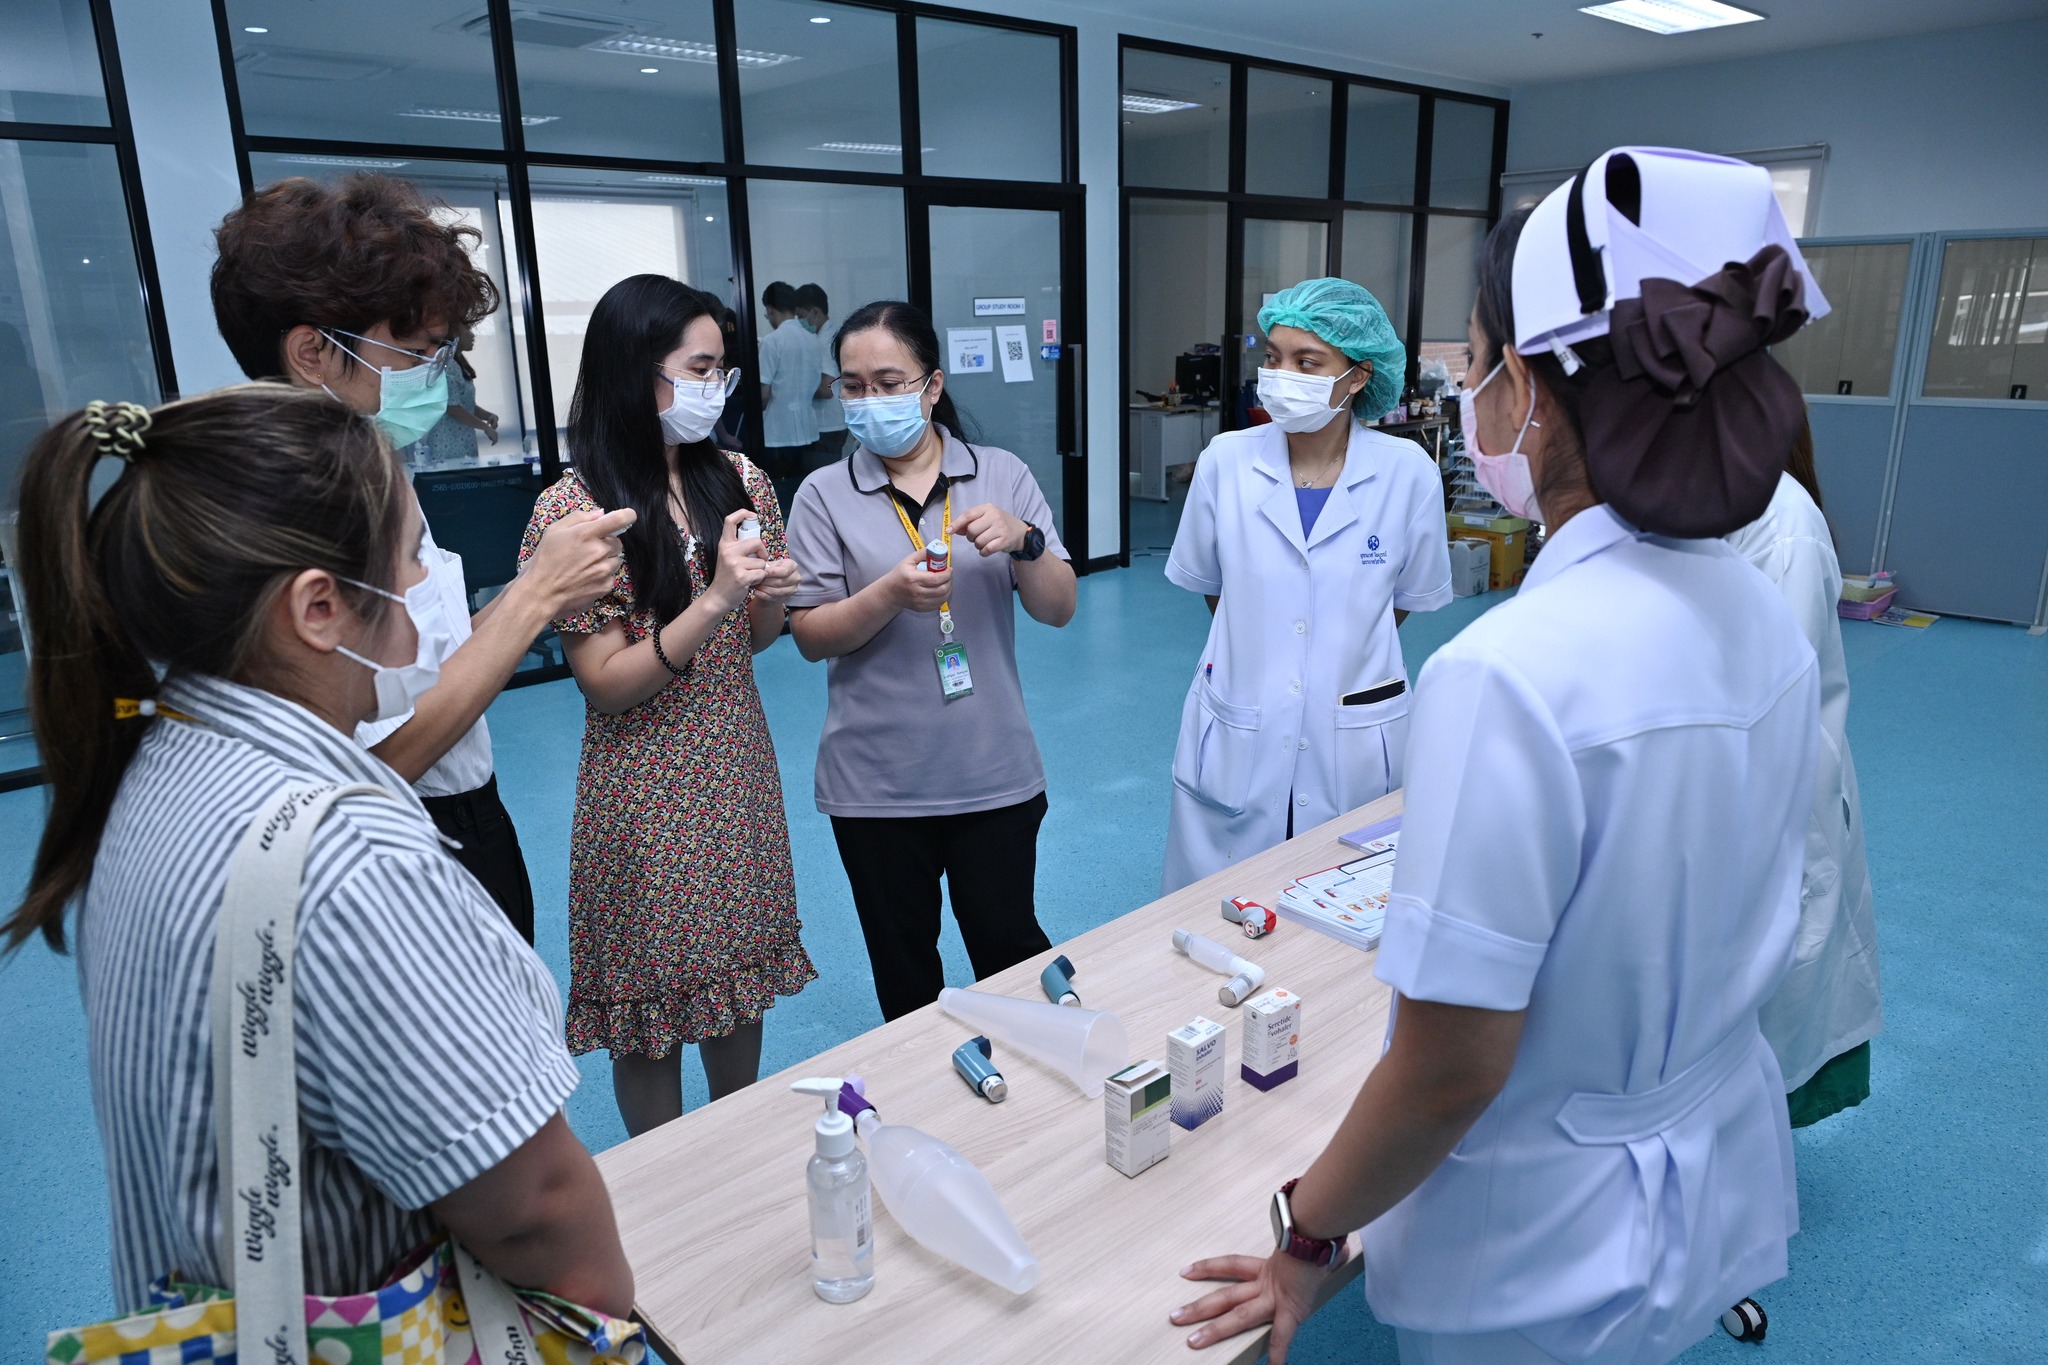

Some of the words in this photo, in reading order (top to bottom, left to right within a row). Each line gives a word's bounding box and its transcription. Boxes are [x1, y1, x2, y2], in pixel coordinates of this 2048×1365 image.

[236, 981, 268, 1058] wiggle
[255, 920, 284, 1005] wiggle.
[1267, 1015, 1292, 1031] Seretide
[1267, 1023, 1292, 1037] Evohaler
[1196, 1039, 1217, 1056] SALVO
[1196, 1048, 1213, 1062] Inhaler
[239, 1187, 276, 1261] wiggle
[258, 1124, 291, 1208] wiggle.
